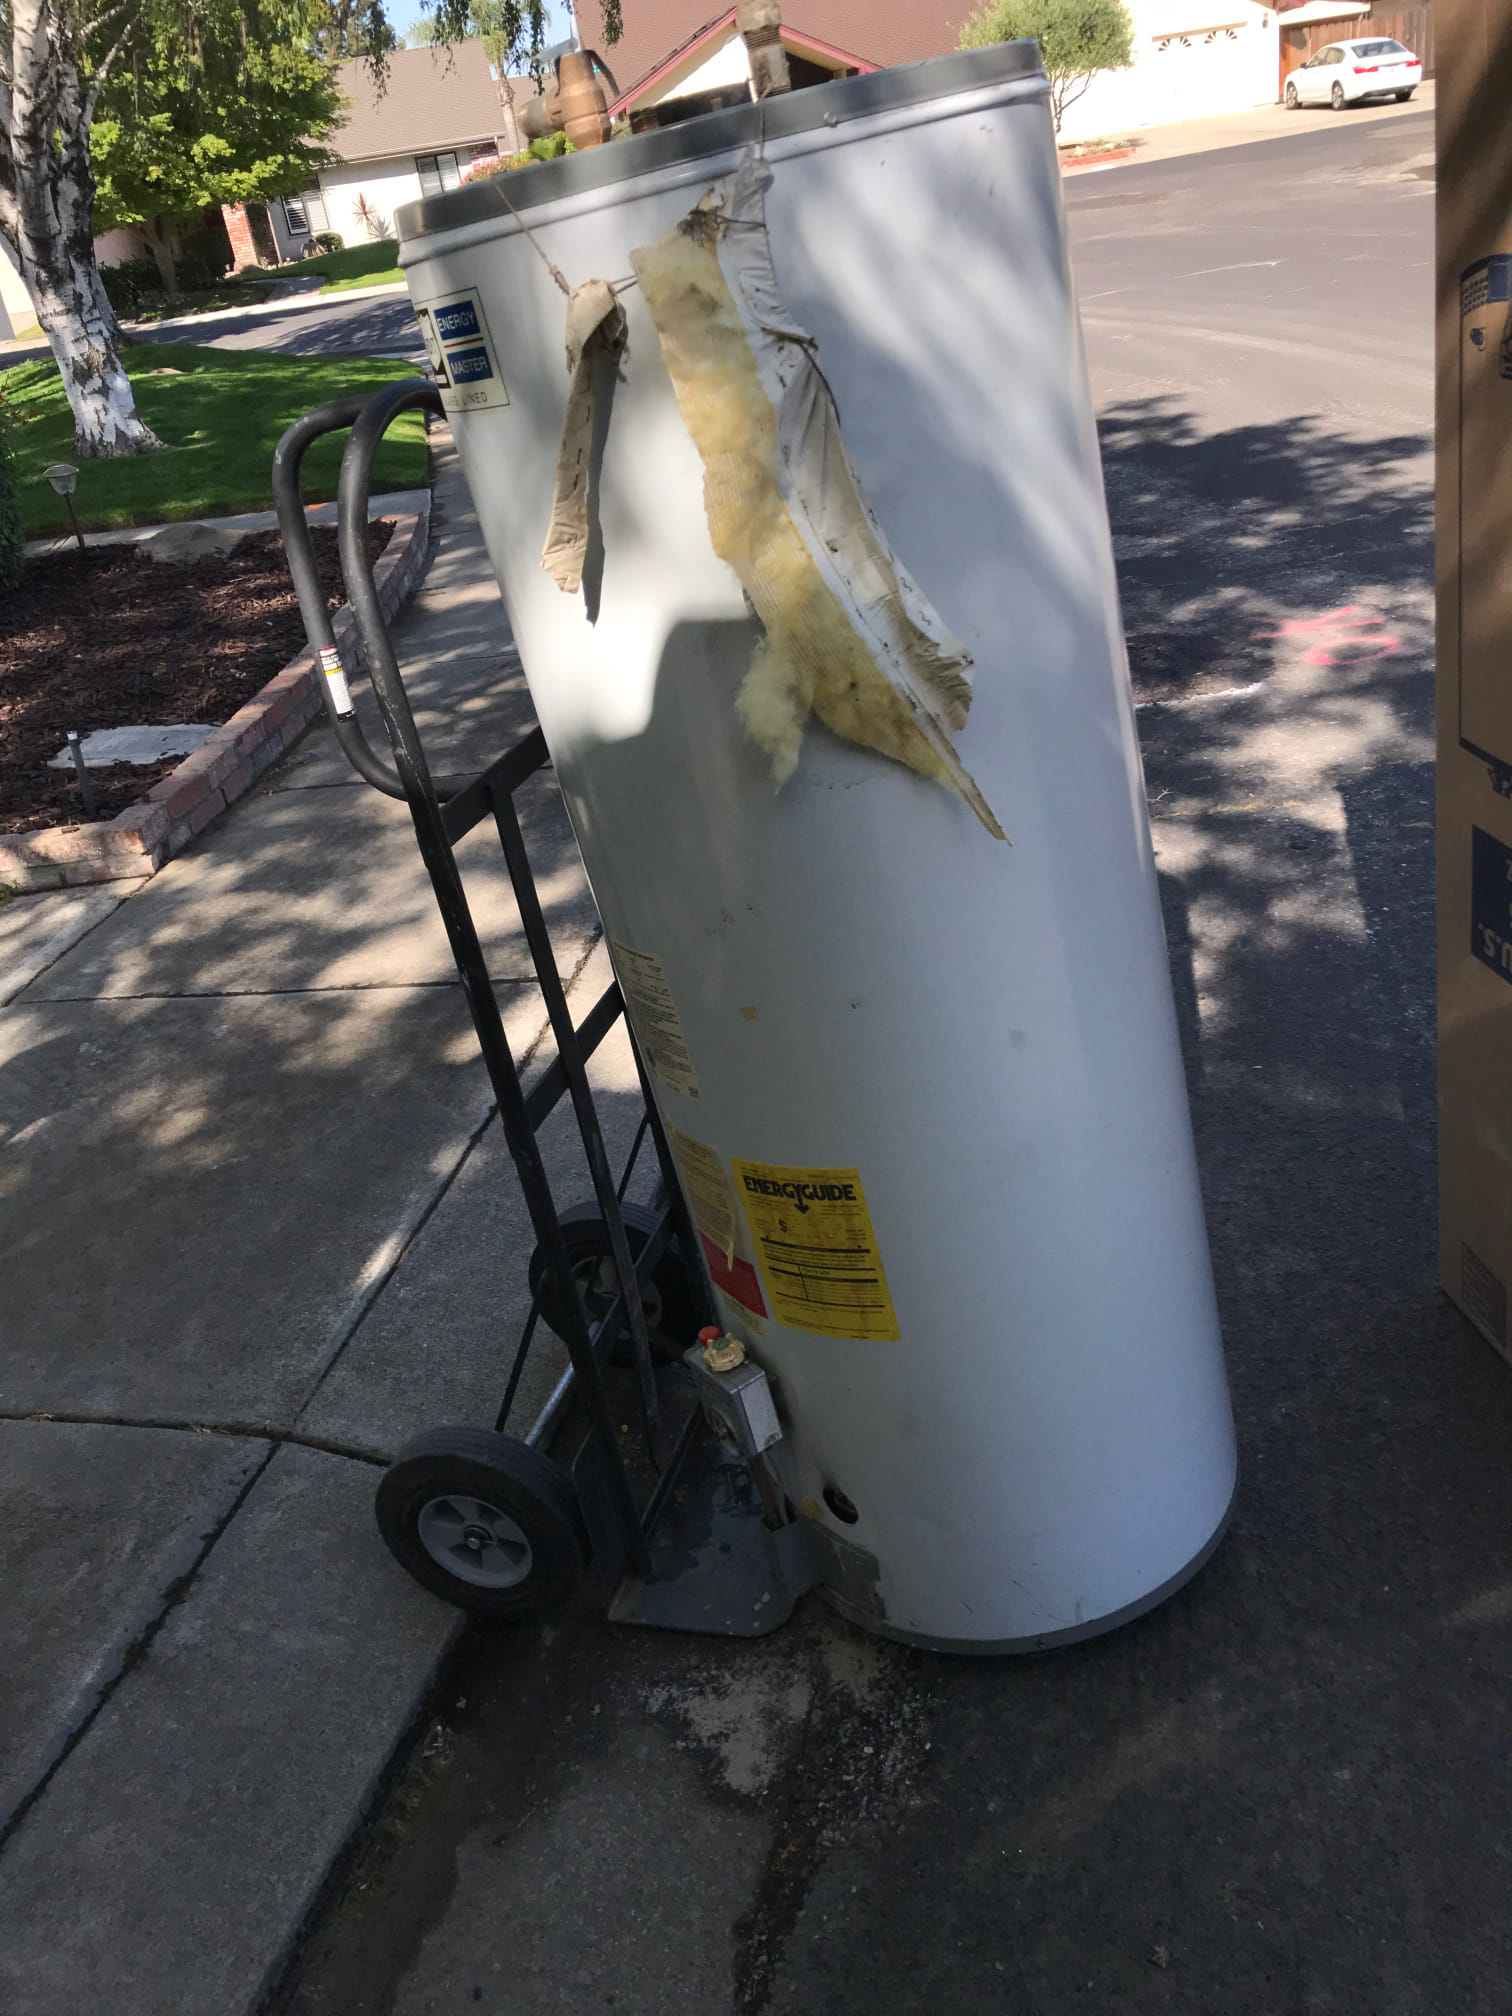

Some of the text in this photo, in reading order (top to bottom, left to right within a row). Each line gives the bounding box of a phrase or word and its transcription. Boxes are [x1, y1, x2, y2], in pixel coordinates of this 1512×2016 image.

[437, 311, 475, 332] ENERGY
[450, 356, 488, 375] MASTER
[742, 1174, 857, 1201] ENERGYGUIDE
